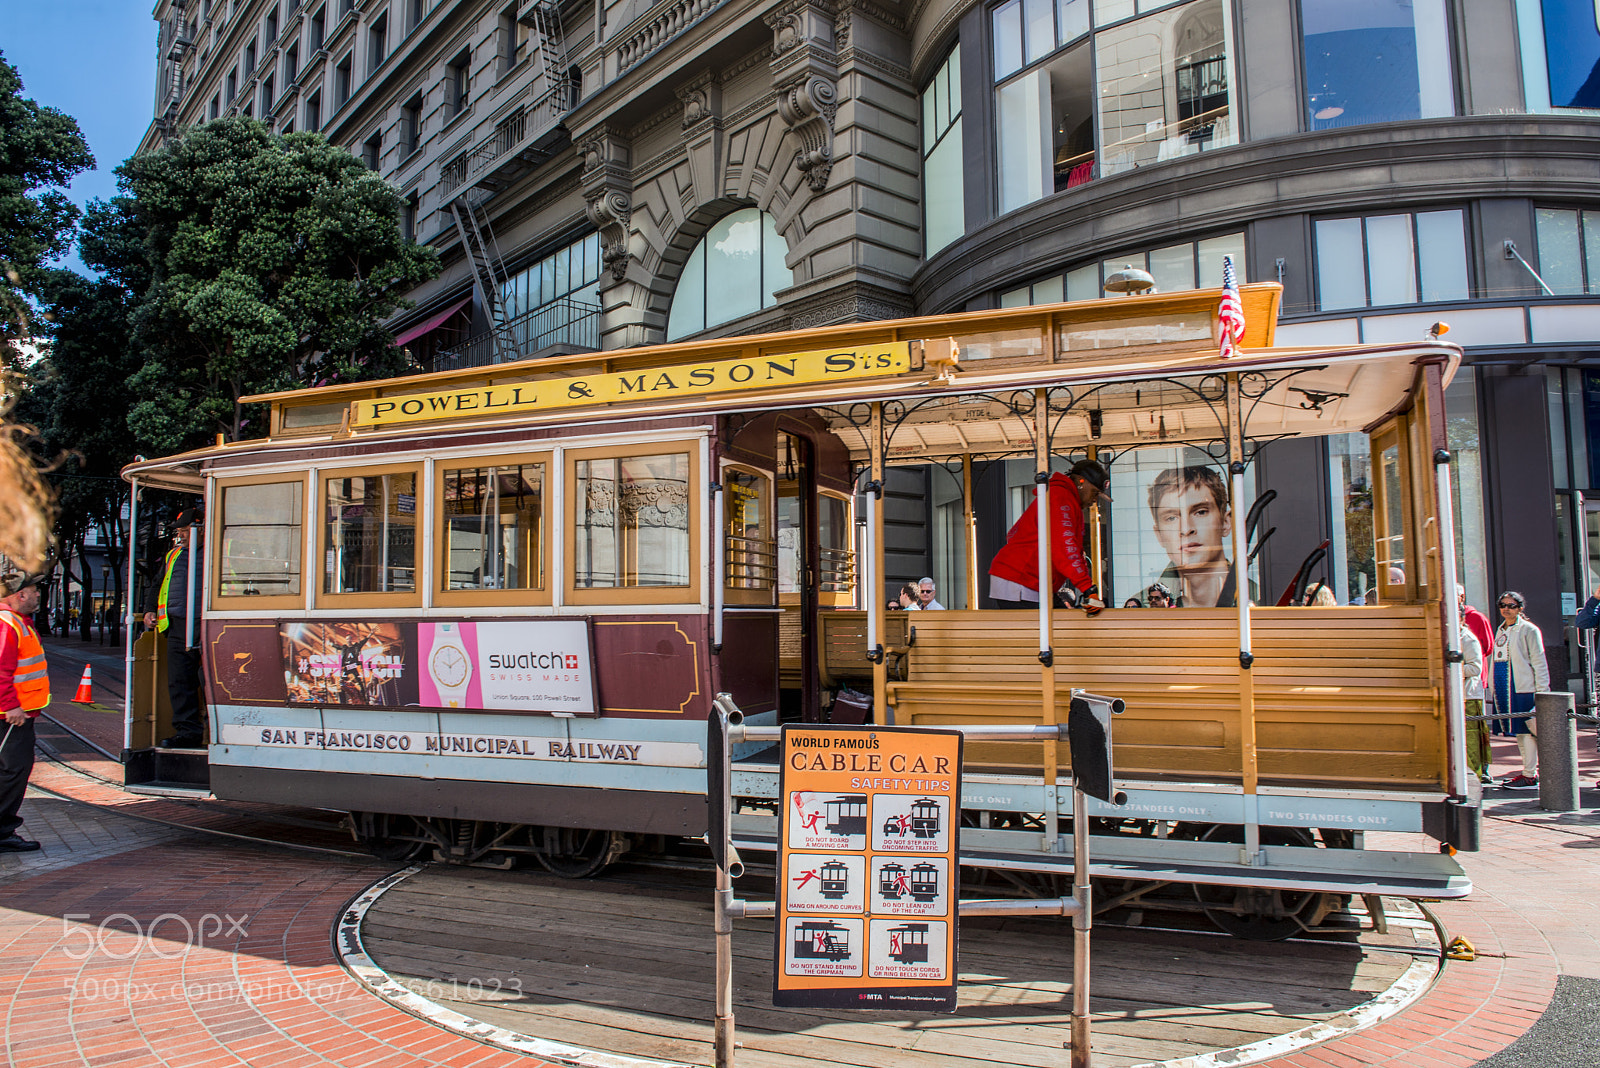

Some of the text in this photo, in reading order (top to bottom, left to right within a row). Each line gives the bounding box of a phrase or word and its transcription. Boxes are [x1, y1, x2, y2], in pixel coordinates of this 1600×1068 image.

[371, 388, 537, 418] POWELL
[567, 381, 595, 399] &
[618, 358, 798, 395] MASON
[966, 409, 985, 418] HYDE
[233, 652, 253, 674] 7
[489, 651, 563, 669] swatch
[261, 728, 642, 760] SAN FRANCISCO MUNICIPAL RAILWAY
[791, 738, 880, 749] WORLD FAMOUS
[791, 752, 951, 774] CABLE CAR
[851, 777, 950, 791] SAFETY TIPS
[987, 796, 1012, 804] ONLY
[1124, 803, 1175, 814] STANDEES
[1179, 806, 1206, 814] ONLY
[1269, 811, 1388, 824] TWO STANDEES ONLY
